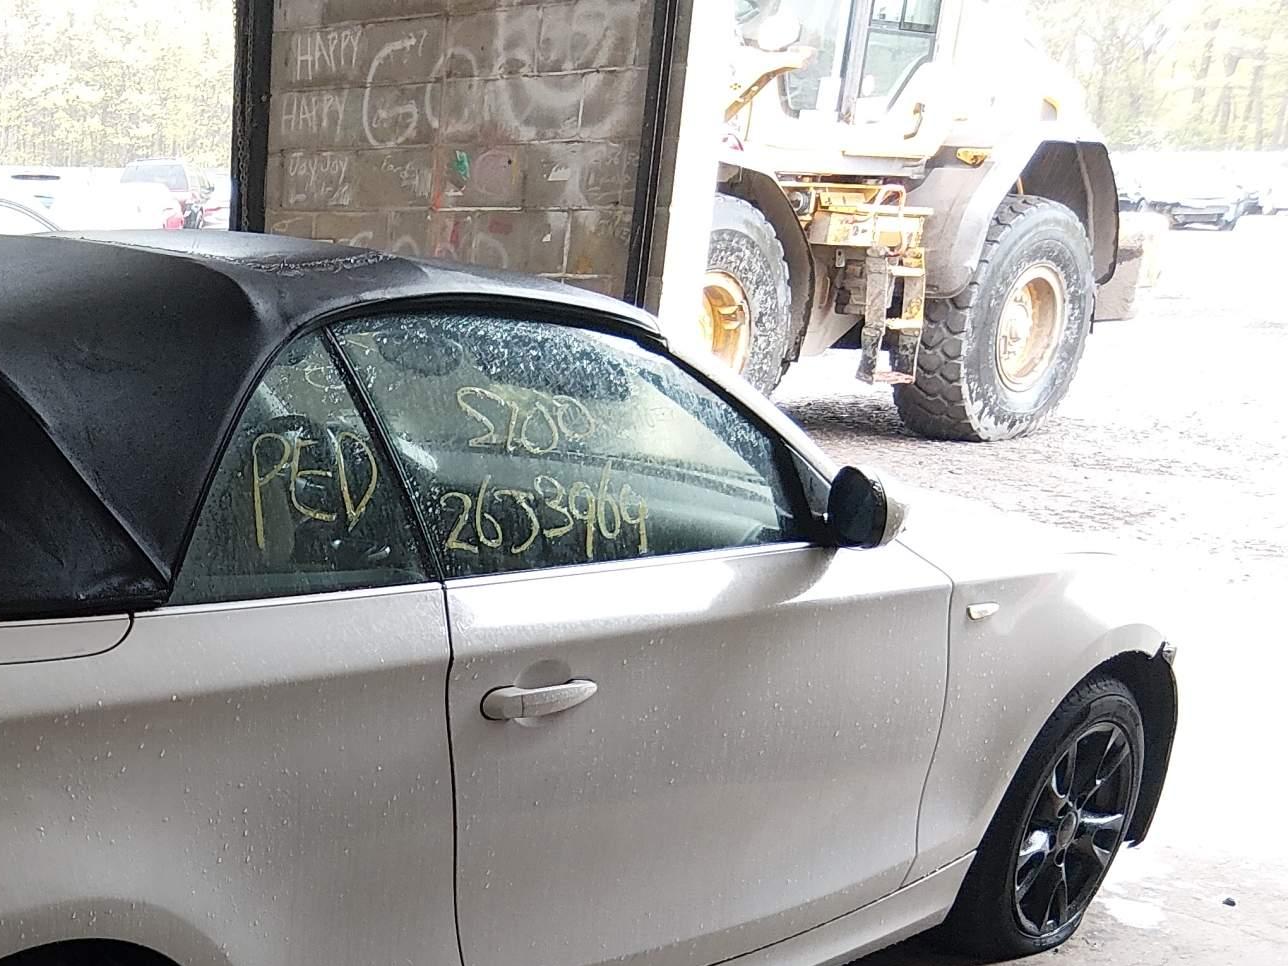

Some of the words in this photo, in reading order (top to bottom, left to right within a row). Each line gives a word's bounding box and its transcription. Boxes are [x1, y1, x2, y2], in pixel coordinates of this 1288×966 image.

[295, 28, 362, 81] HAPPY
[280, 88, 350, 142] HAPPY
[252, 431, 379, 552] PED
